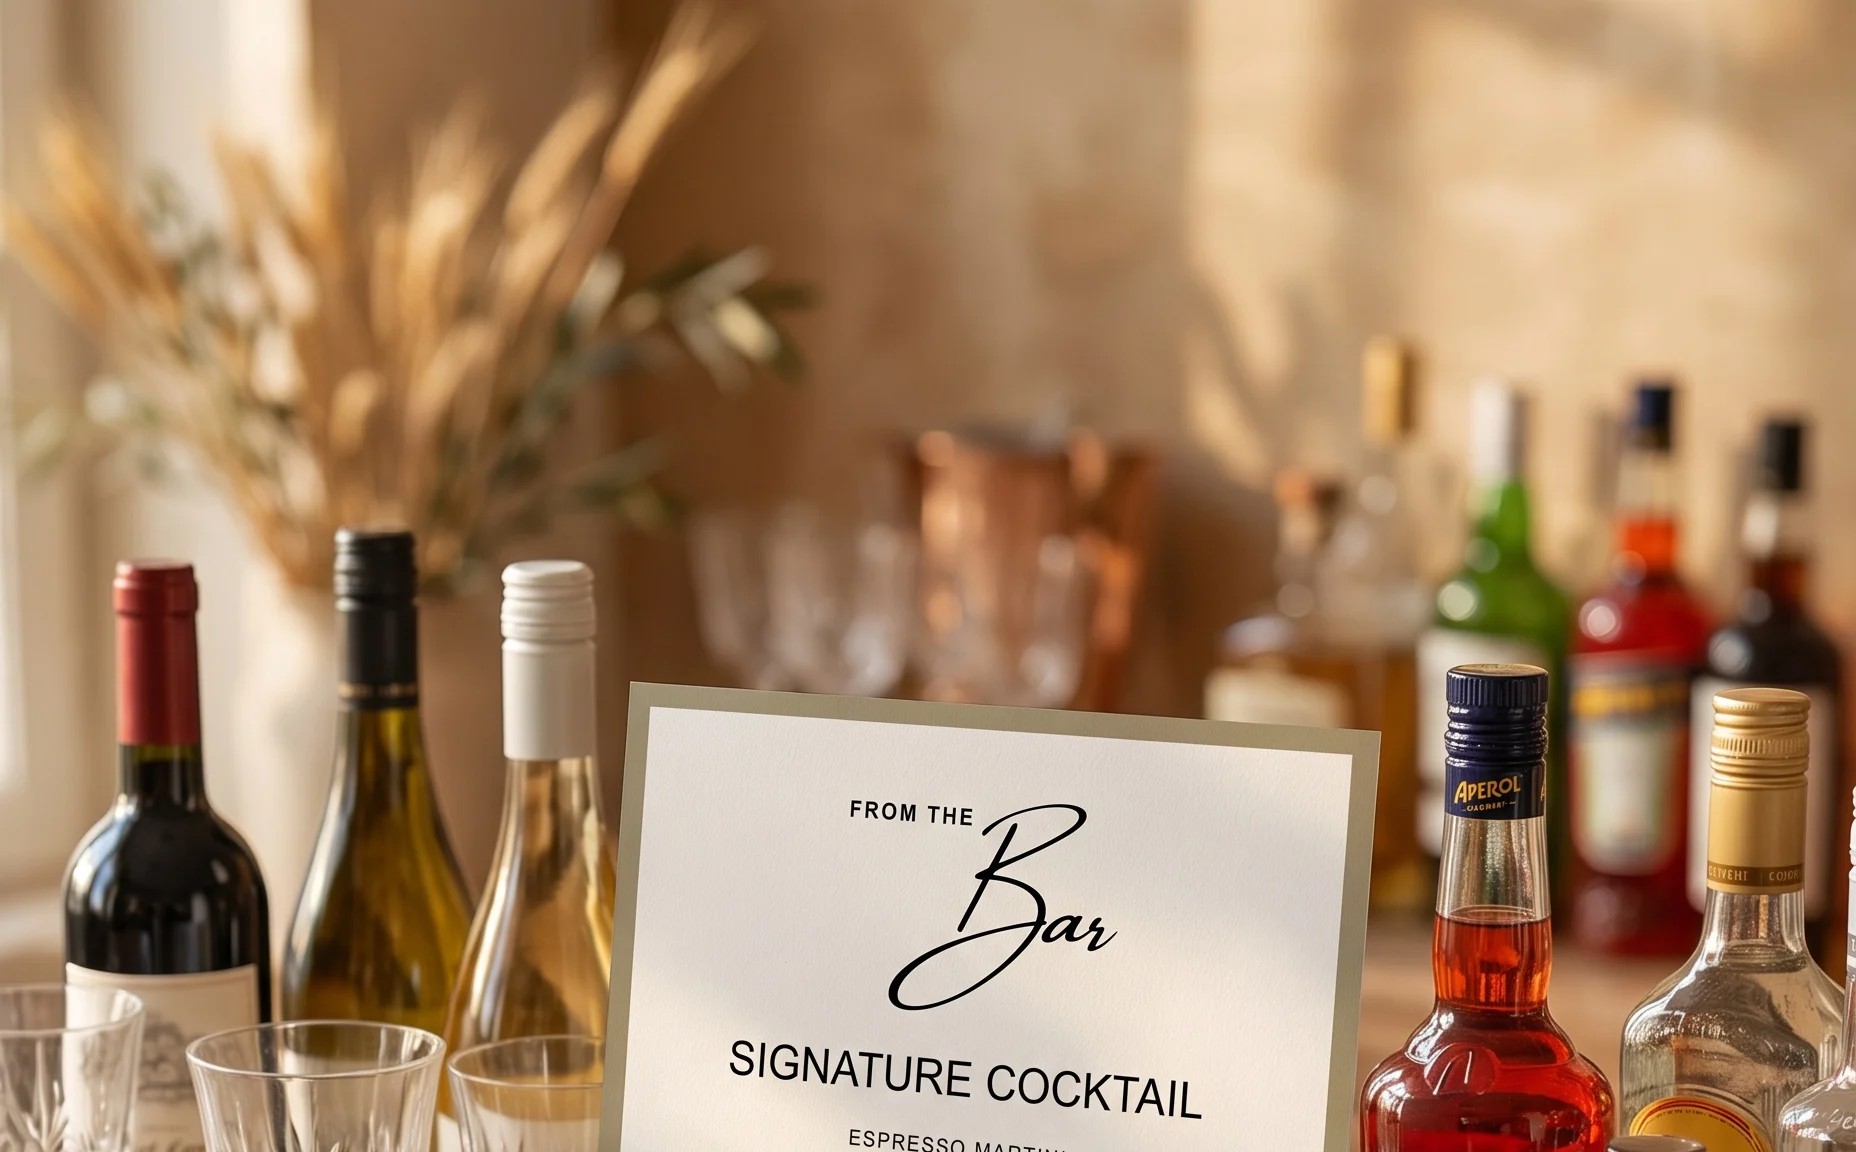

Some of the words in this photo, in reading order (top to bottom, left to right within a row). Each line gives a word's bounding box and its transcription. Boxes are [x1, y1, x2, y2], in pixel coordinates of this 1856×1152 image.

[850, 799, 917, 822] FROM
[927, 805, 973, 826] THE
[1453, 775, 1521, 804] APEROL
[888, 803, 1118, 1011] Bar
[729, 1039, 972, 1098] SIGNATURE
[987, 1064, 1202, 1120] COCKTAIL
